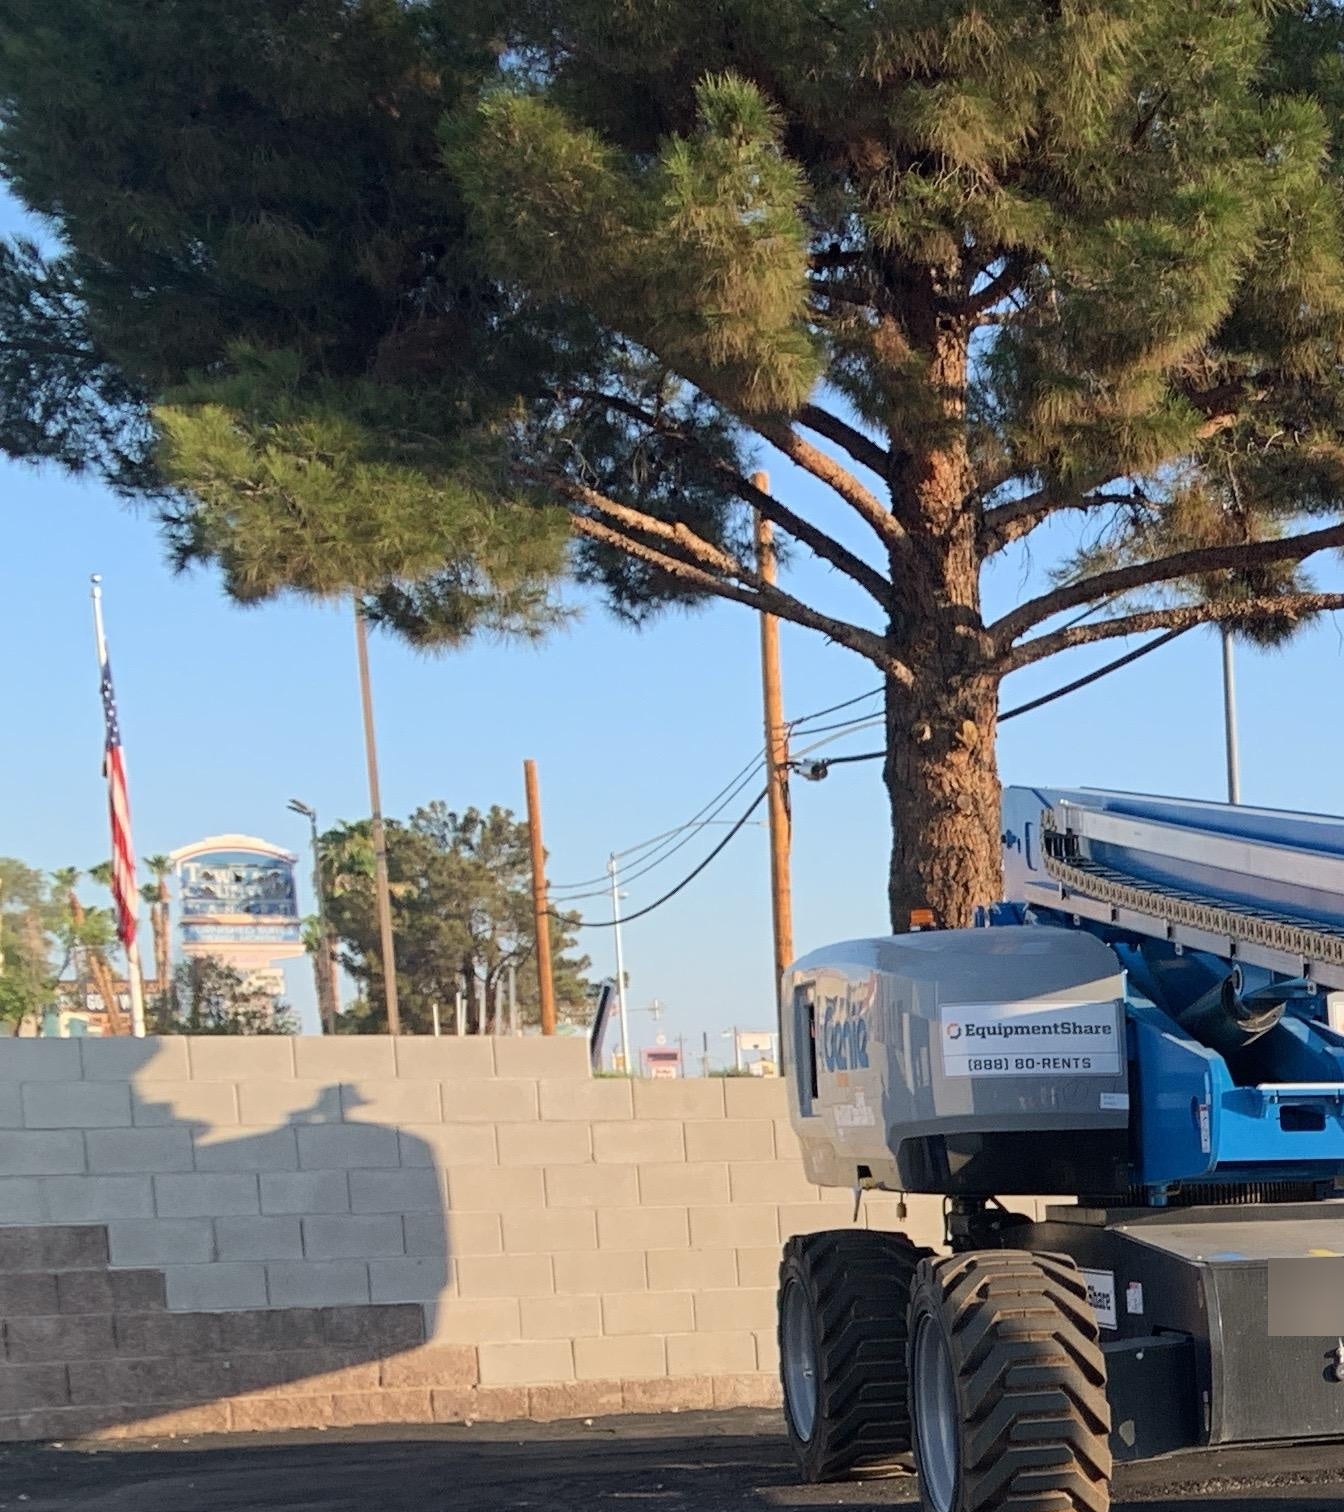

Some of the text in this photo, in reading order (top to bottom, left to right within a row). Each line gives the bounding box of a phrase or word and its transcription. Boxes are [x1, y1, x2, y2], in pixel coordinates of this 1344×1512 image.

[965, 1022, 1112, 1039] EquipmentShare
[968, 1057, 1091, 1071] (888) 80-RENTS
